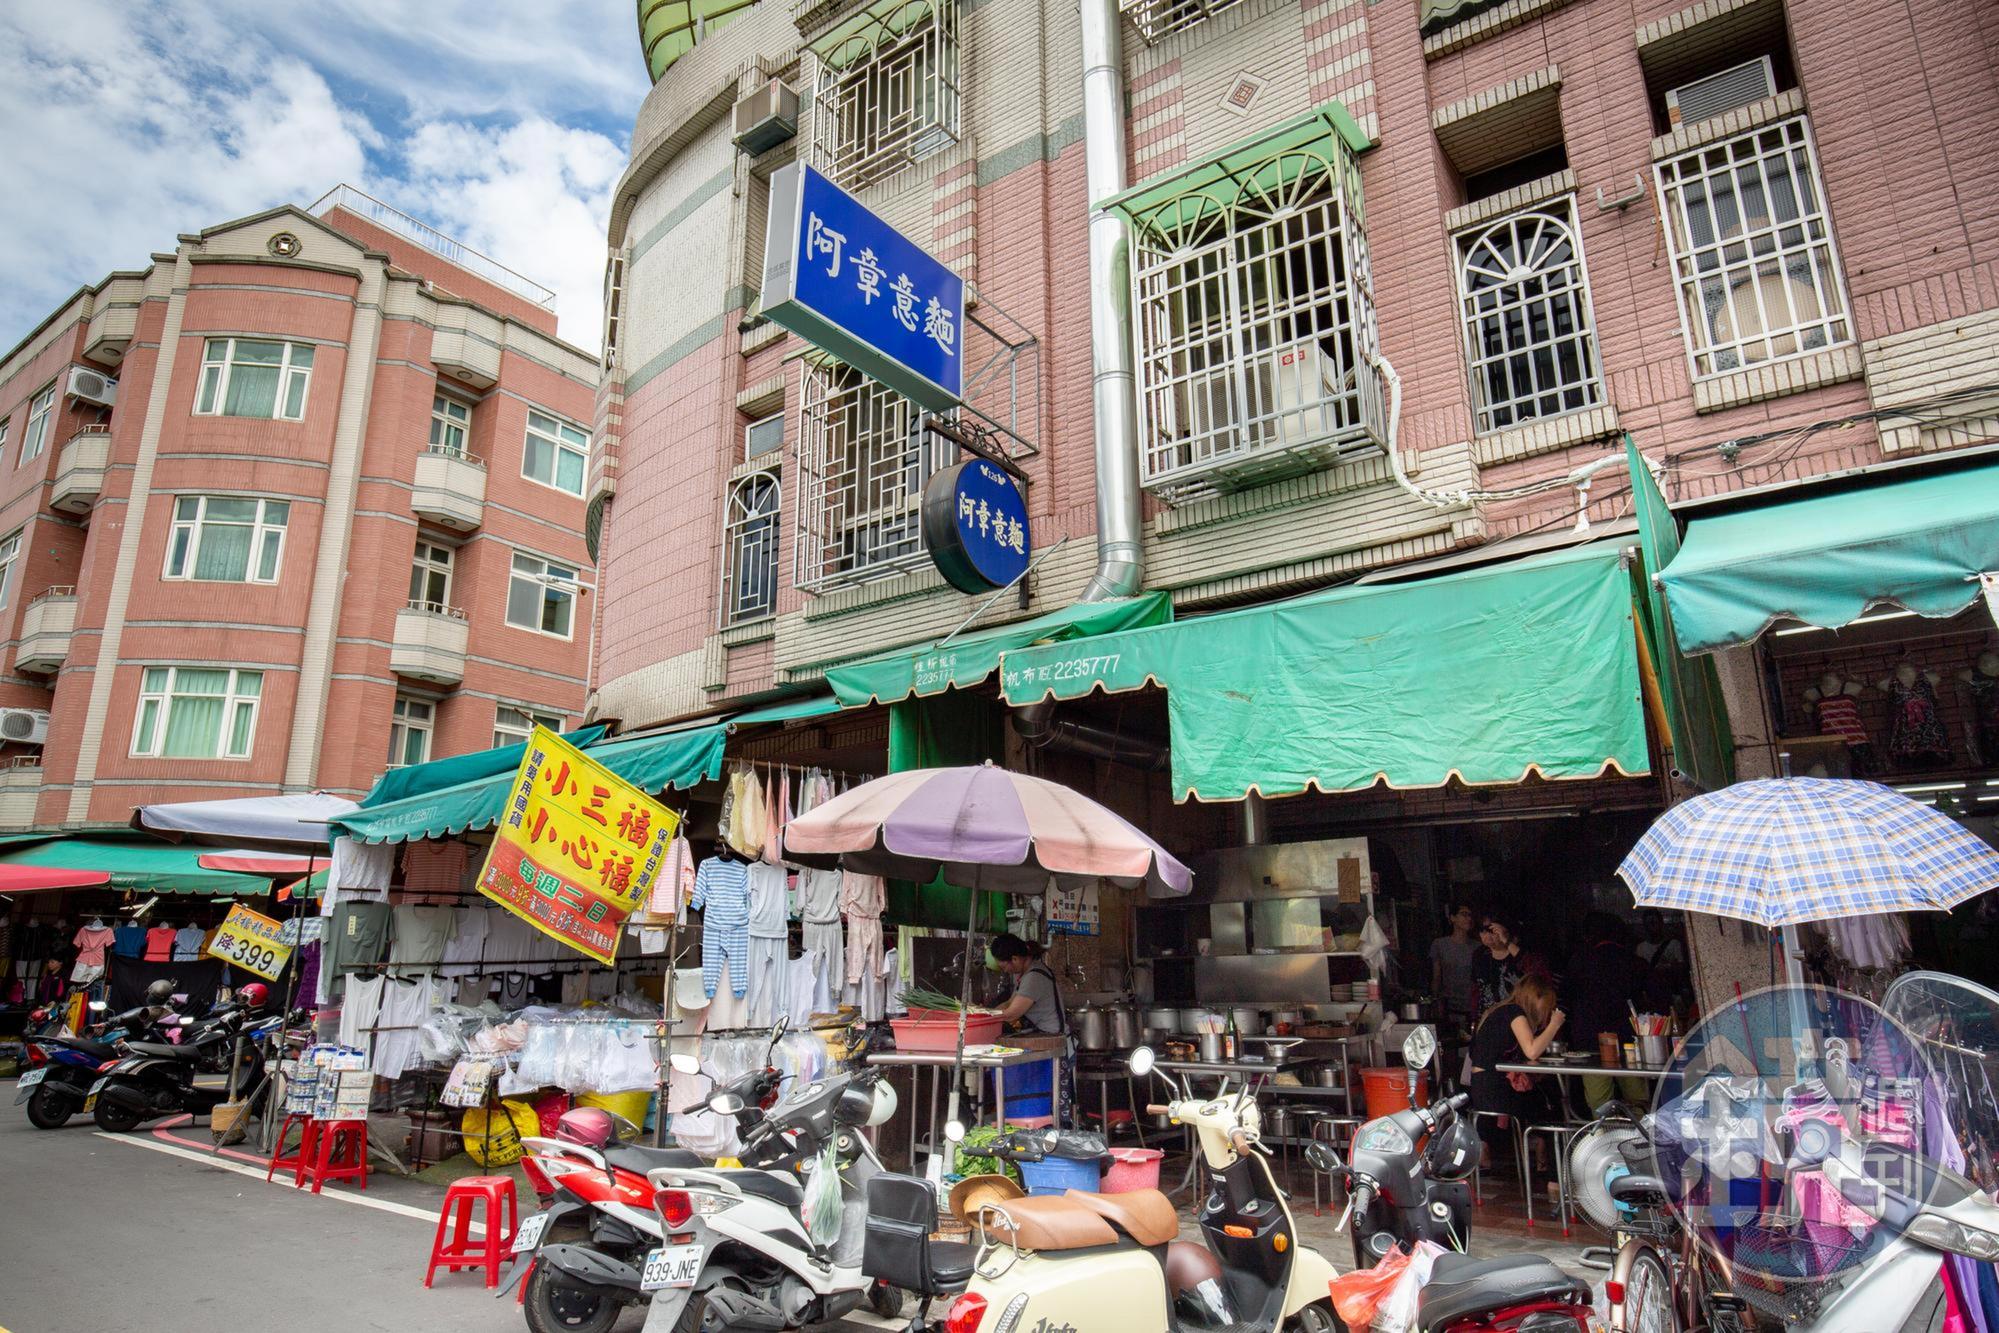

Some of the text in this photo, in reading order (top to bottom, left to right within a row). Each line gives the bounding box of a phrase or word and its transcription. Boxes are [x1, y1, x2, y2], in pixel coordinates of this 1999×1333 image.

[806, 210, 956, 358] 阿章意麵
[958, 490, 1025, 555] 阿章意麵
[915, 668, 956, 687] 2235777
[1054, 653, 1121, 681] 2235777
[506, 748, 546, 831] 請愛用國貨
[544, 760, 652, 850] 小三福
[527, 806, 635, 898] 小心福
[232, 938, 275, 972] 399
[643, 1258, 699, 1283] 939-JNE
